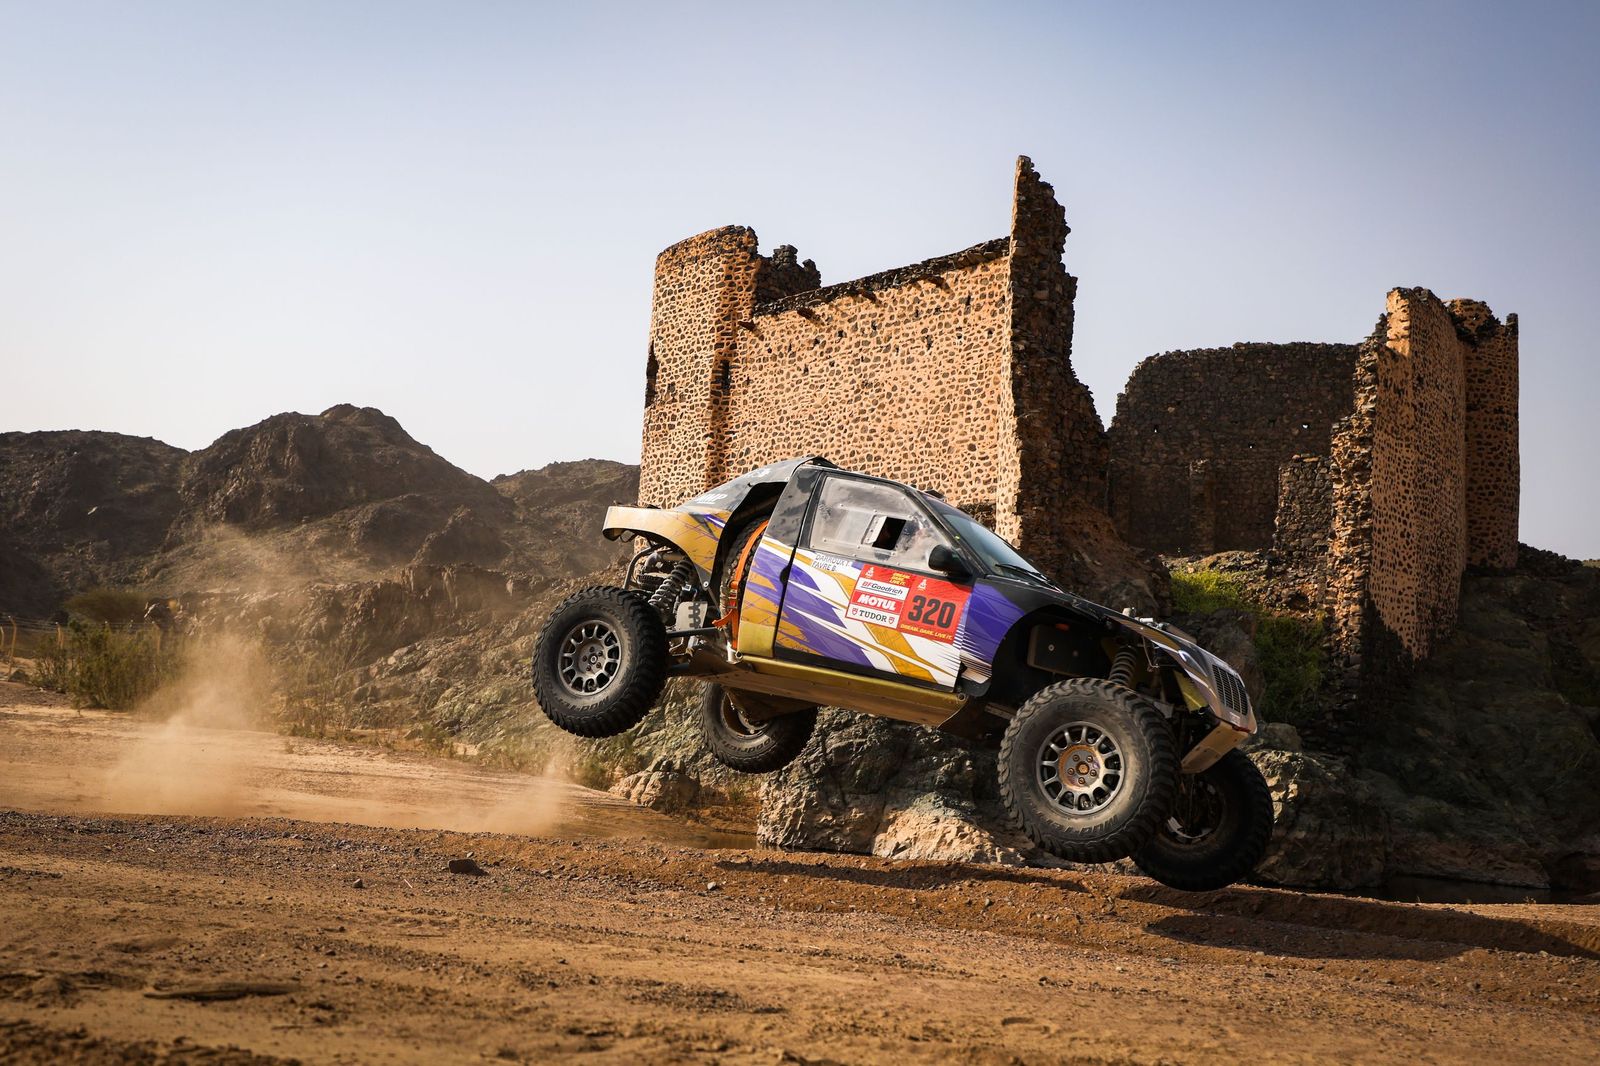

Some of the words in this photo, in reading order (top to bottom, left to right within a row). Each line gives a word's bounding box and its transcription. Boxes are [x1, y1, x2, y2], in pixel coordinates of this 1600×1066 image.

[862, 581, 903, 595] BFGoodrich
[857, 593, 897, 611] MOTUL
[859, 610, 887, 622] TUDOR
[908, 595, 956, 629] 320
